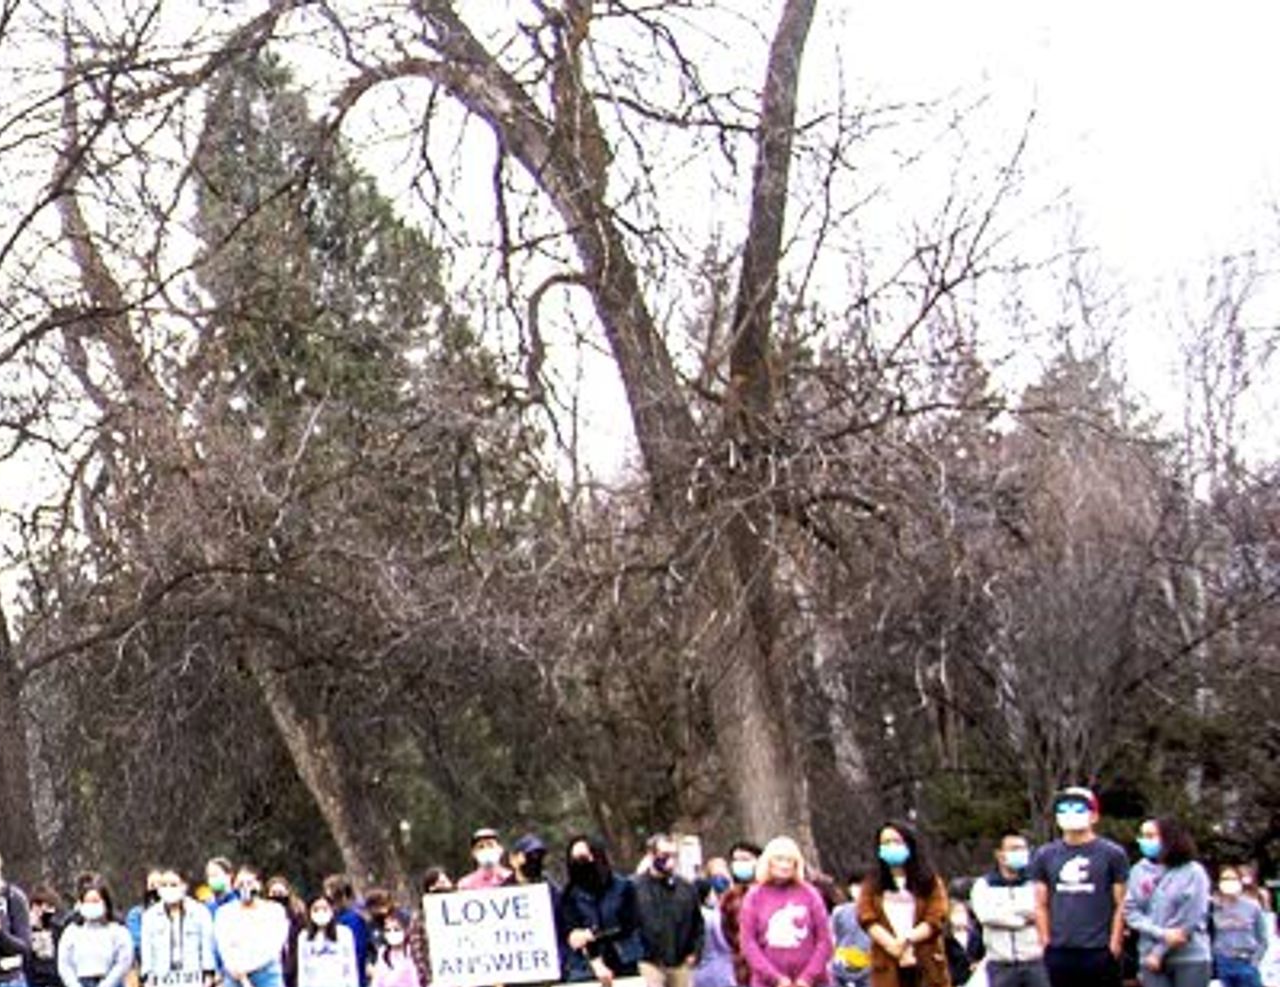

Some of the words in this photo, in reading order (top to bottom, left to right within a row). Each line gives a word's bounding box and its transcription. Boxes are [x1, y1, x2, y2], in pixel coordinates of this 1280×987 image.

[440, 895, 531, 926] LOVE
[494, 929, 535, 945] the
[439, 950, 551, 975] ANSWER
